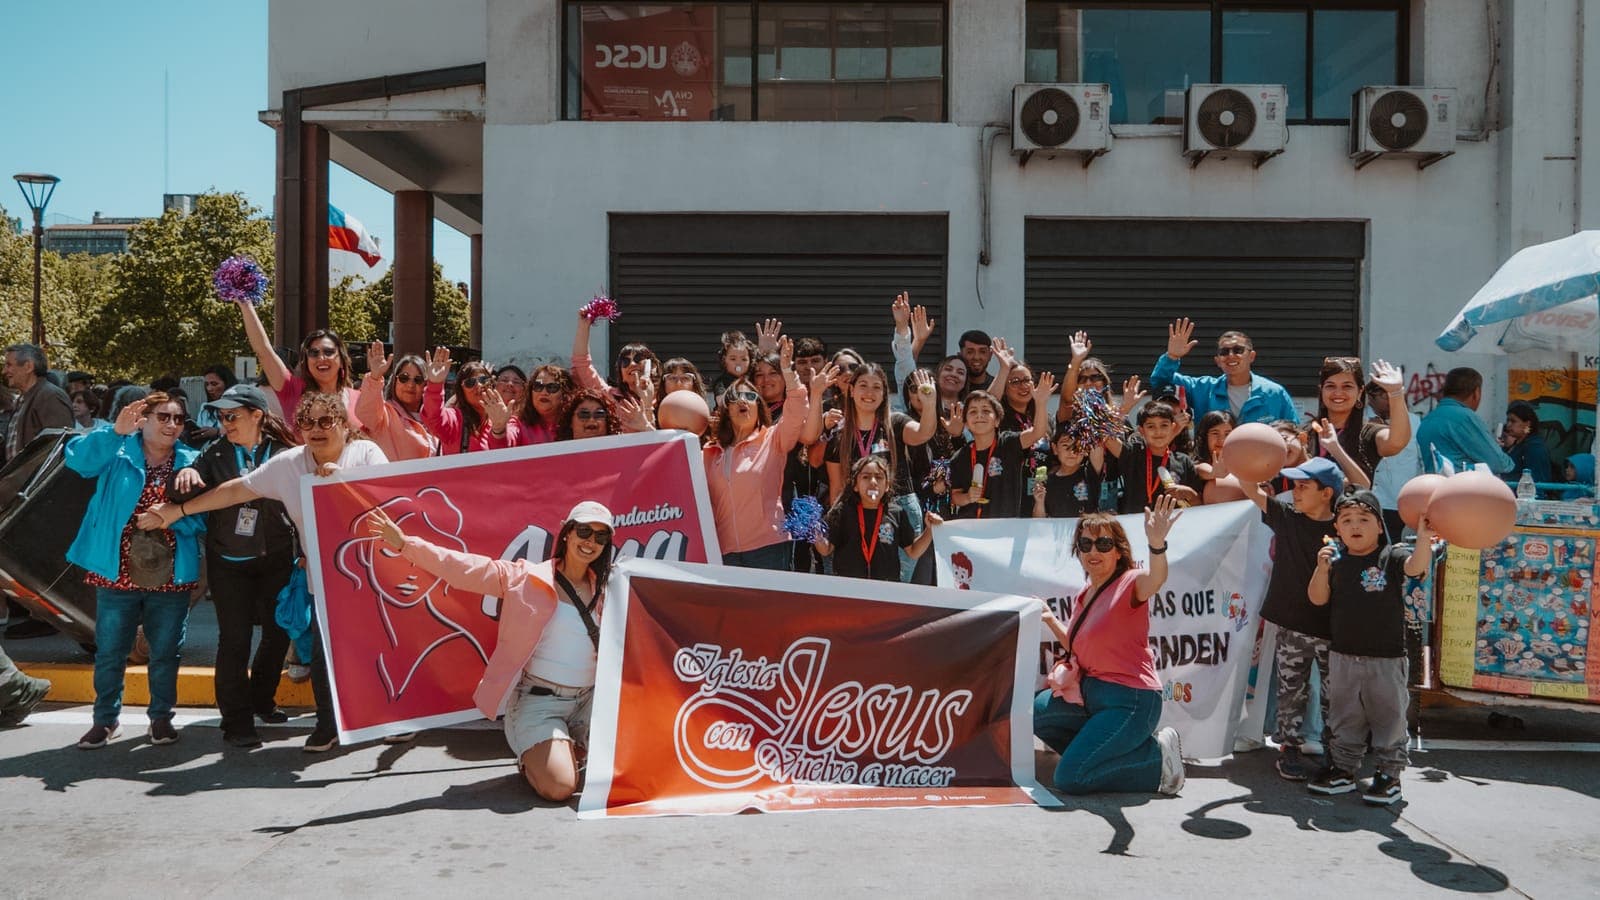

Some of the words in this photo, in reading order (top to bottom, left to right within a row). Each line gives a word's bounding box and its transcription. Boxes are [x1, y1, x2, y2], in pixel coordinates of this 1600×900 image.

[1182, 589, 1215, 617] QUE
[674, 643, 780, 696] Iglesia
[704, 720, 755, 751] con
[755, 738, 857, 785] Vuelvo
[859, 762, 884, 786] a
[884, 763, 956, 787] nacer
